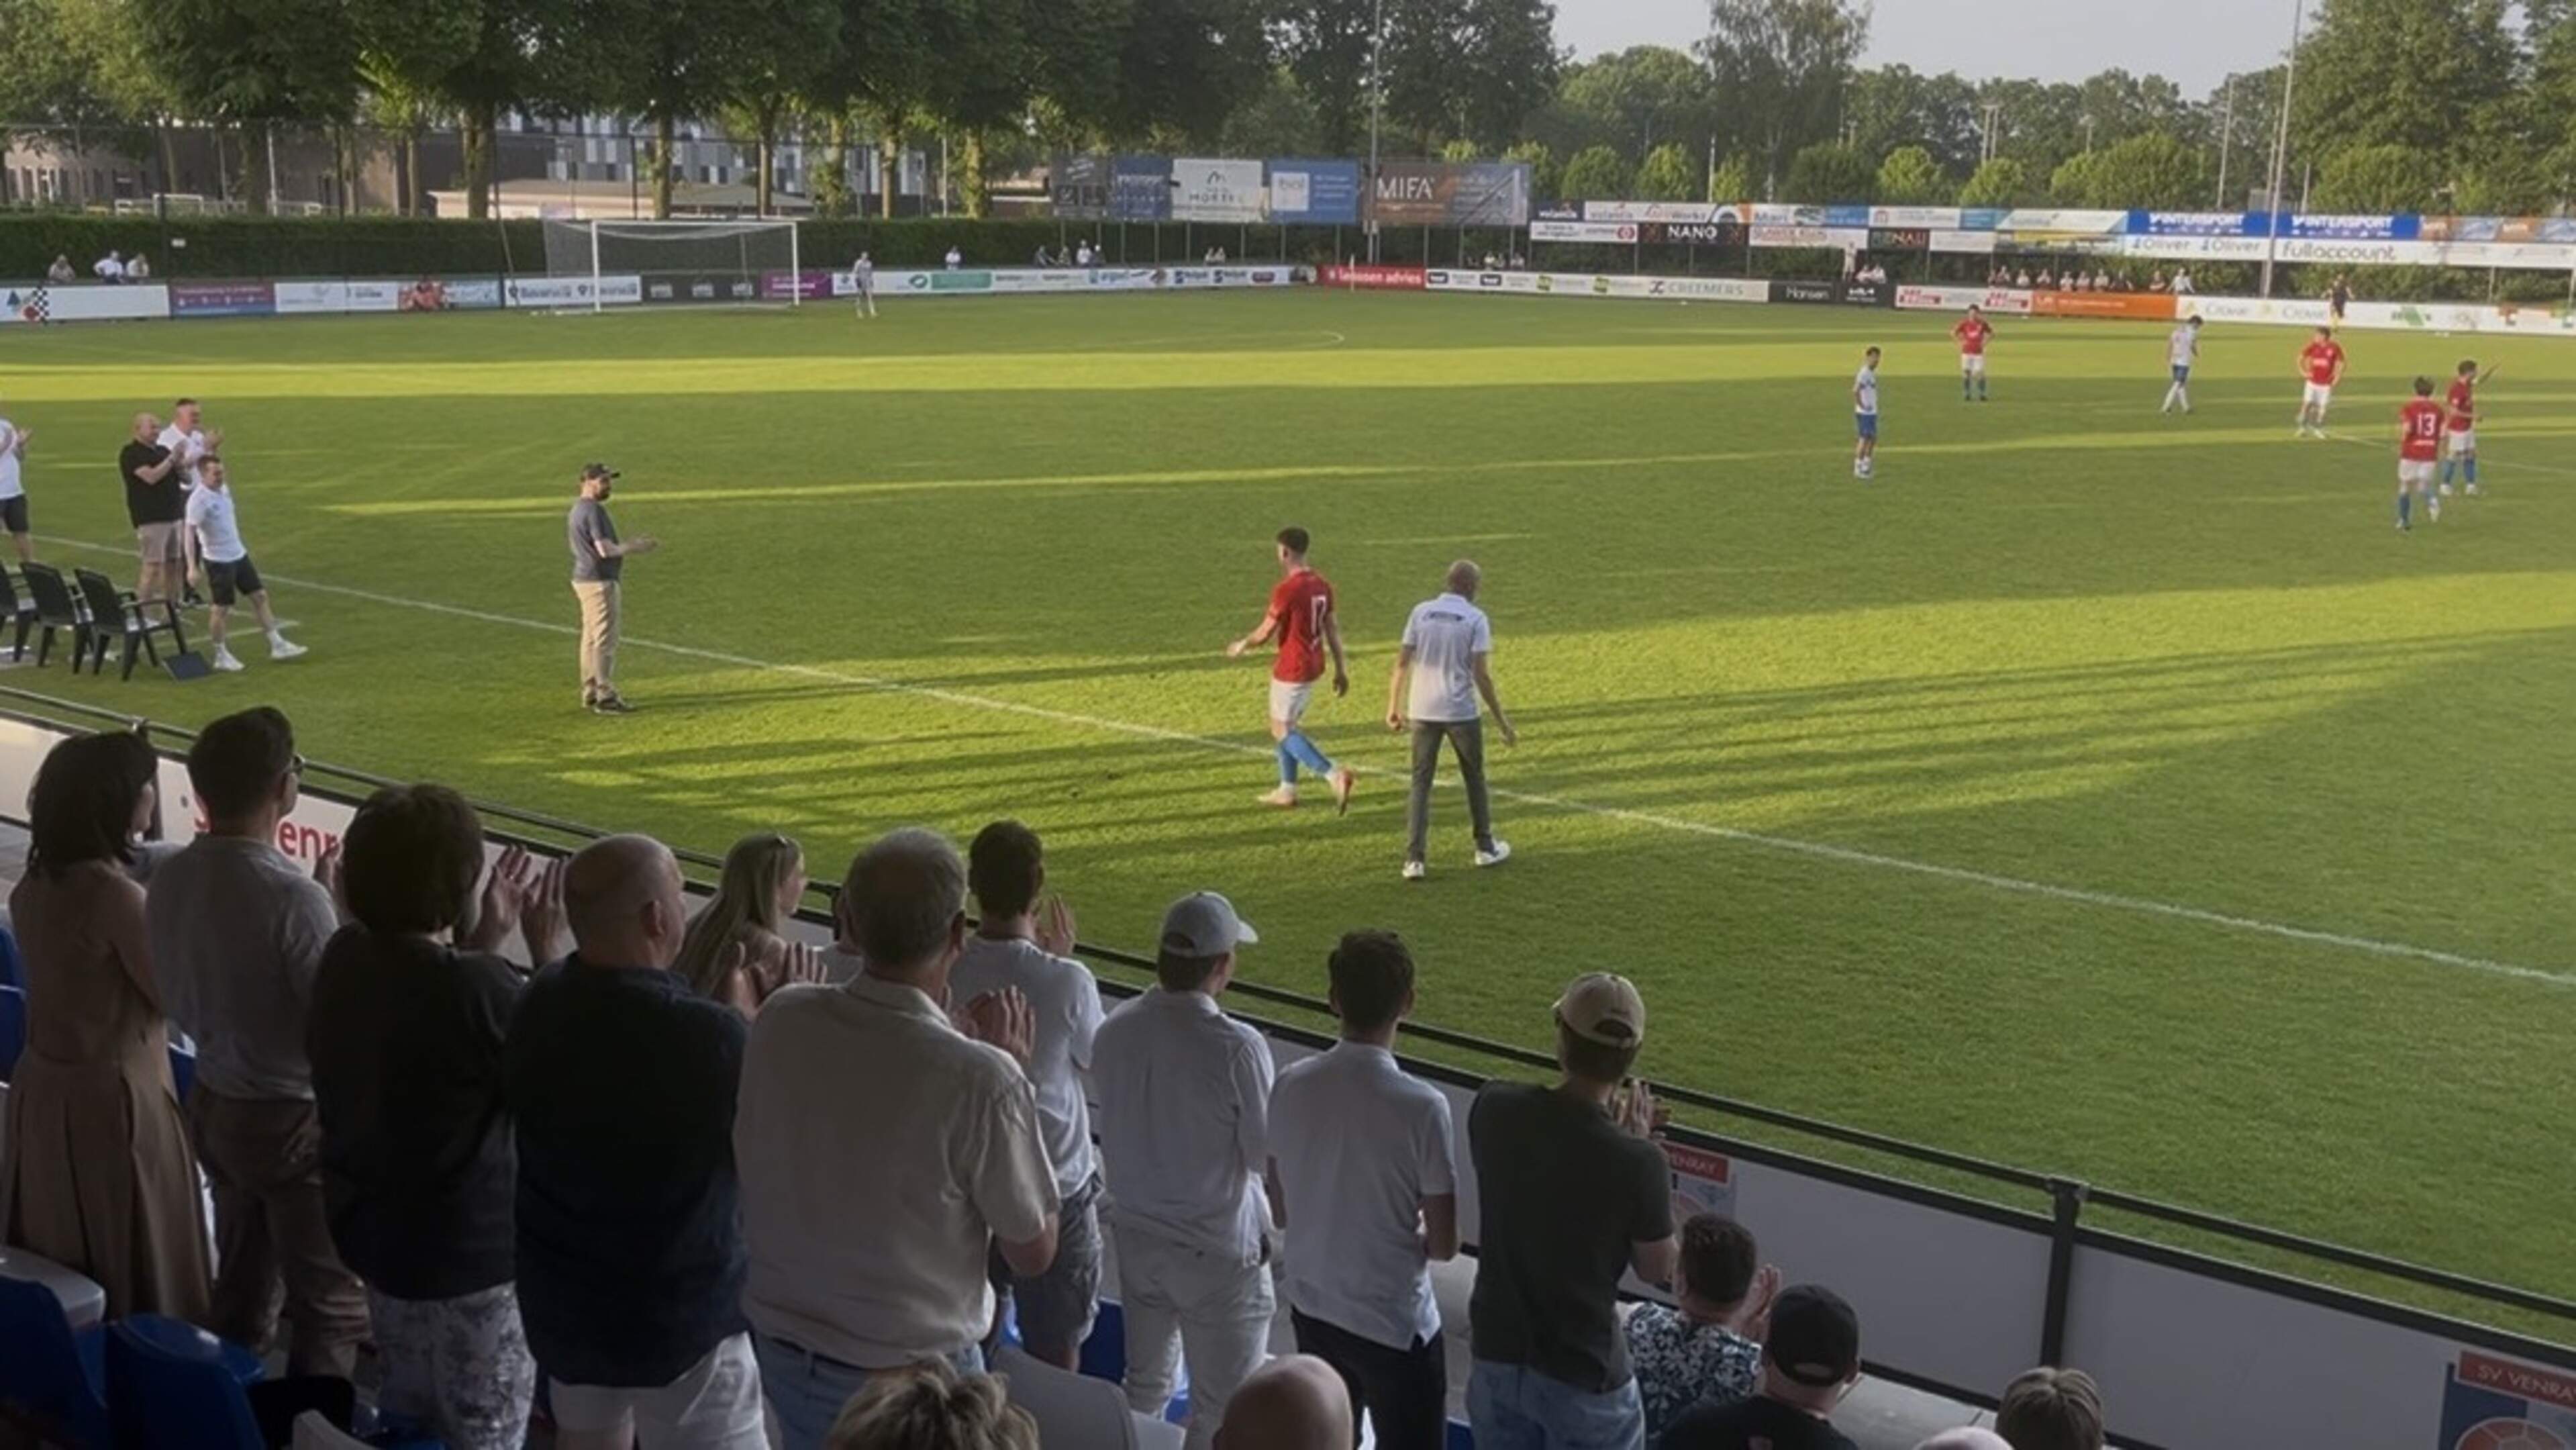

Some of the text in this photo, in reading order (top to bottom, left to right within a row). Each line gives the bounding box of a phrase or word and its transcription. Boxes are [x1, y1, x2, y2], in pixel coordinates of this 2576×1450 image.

[1377, 177, 1430, 200] MIFA
[1667, 225, 1718, 239] NANO
[2418, 412, 2436, 436] 13
[2478, 1364, 2576, 1402] SV VENRA
